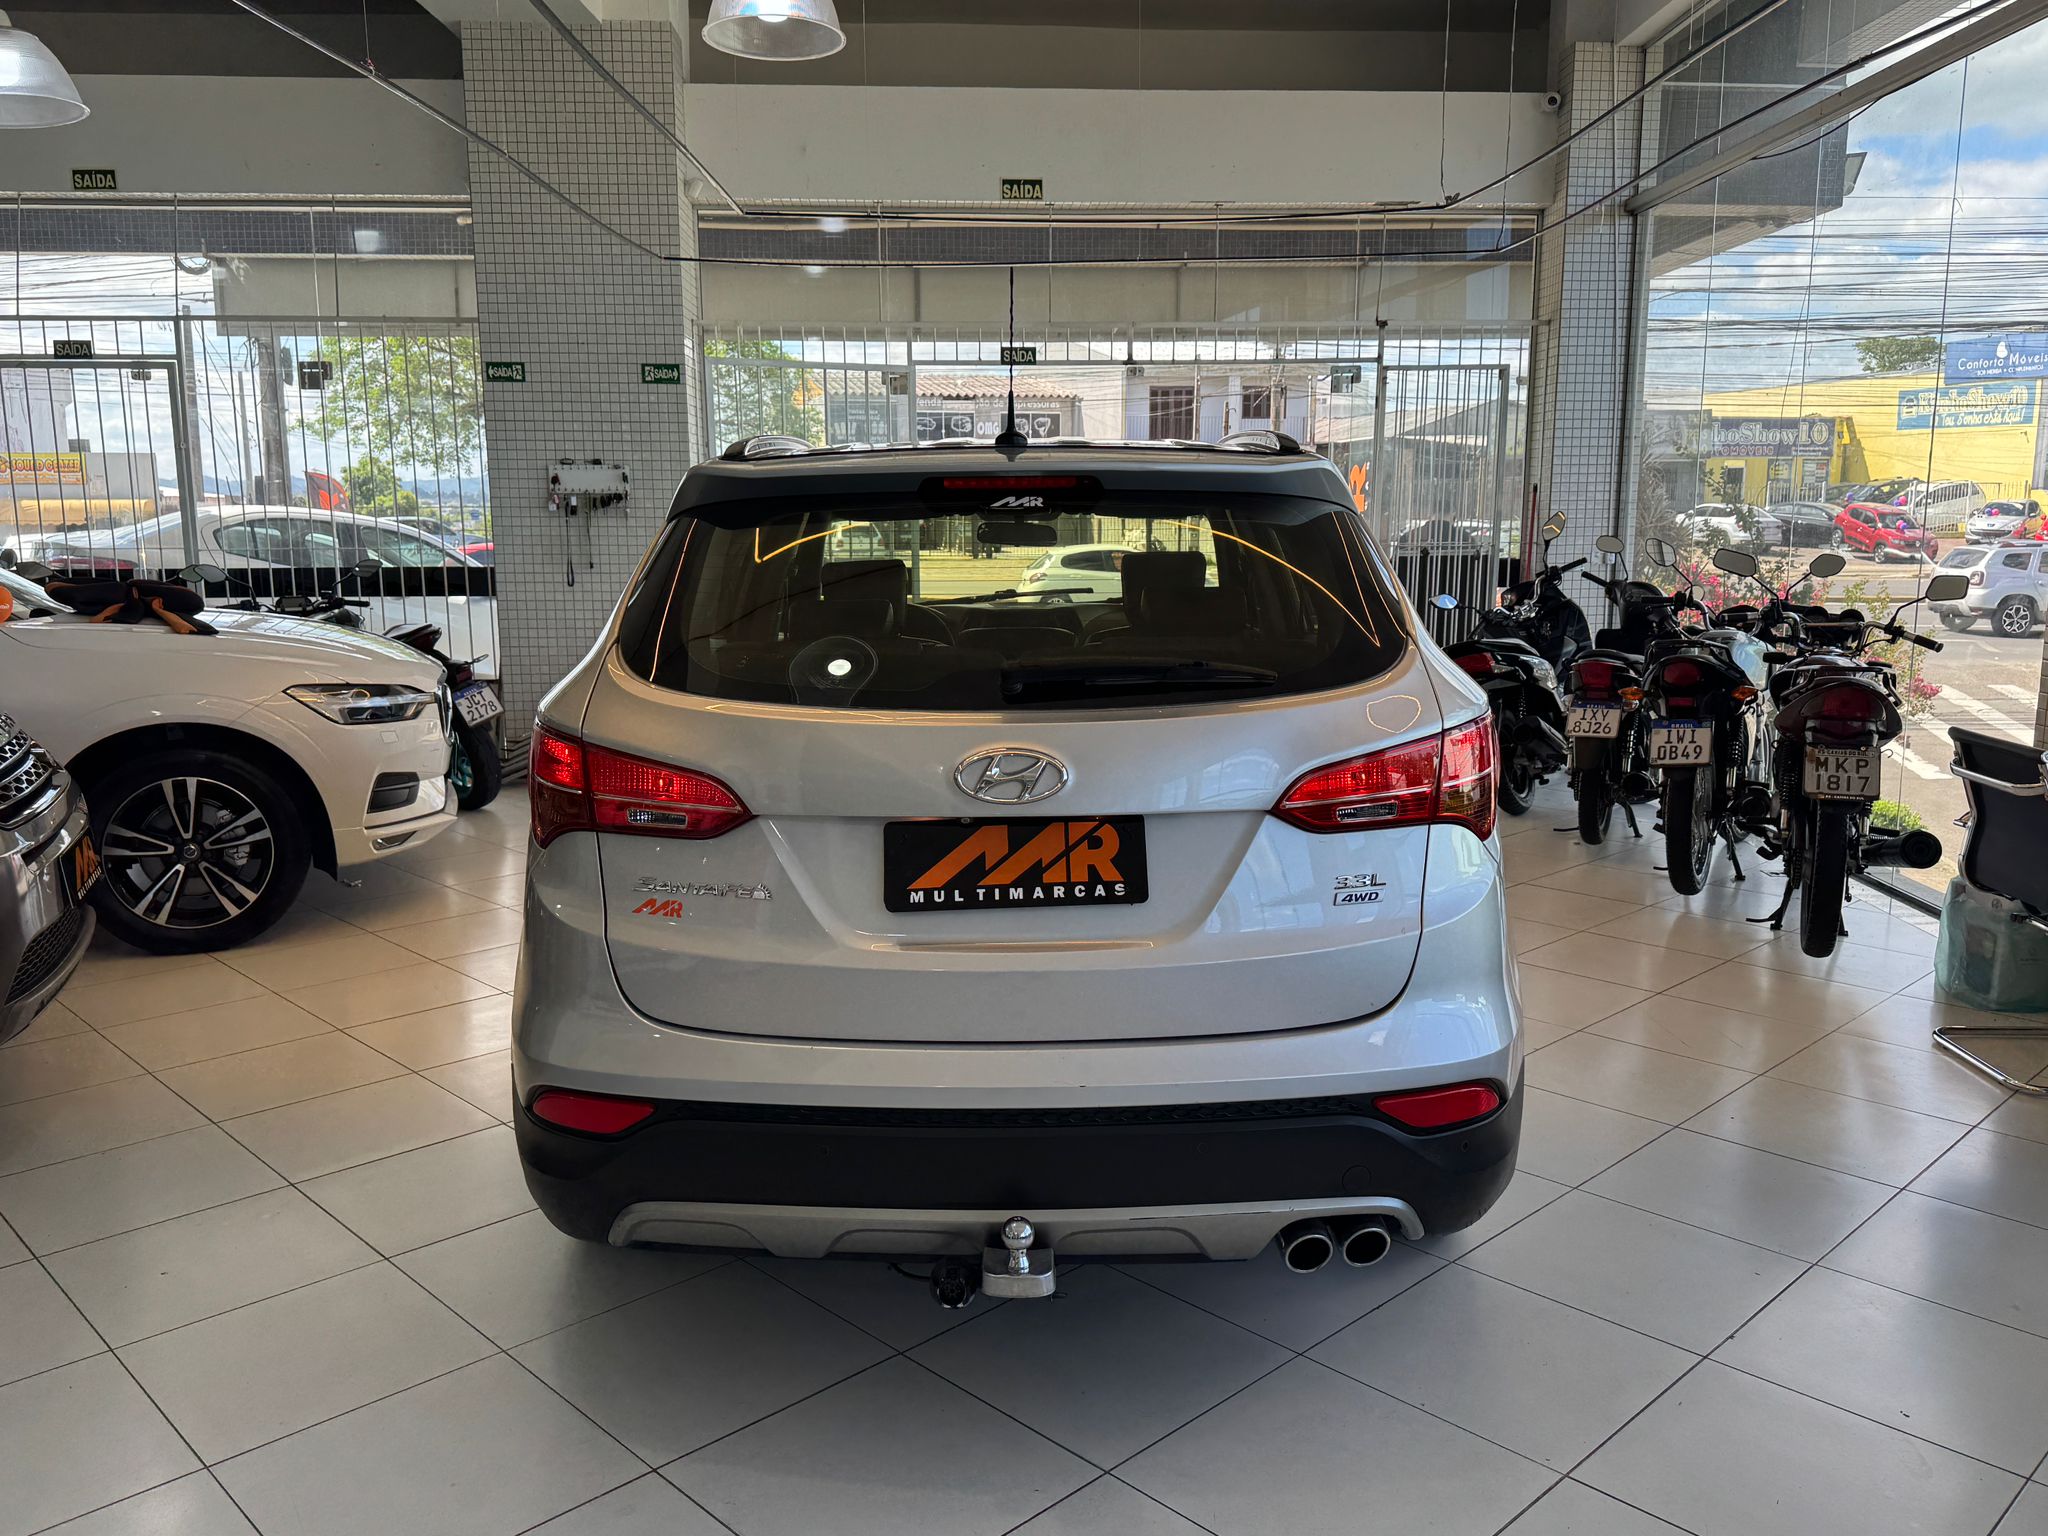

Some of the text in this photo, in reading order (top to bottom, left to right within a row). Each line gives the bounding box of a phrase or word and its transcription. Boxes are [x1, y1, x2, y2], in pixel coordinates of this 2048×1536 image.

[74, 171, 116, 188] SAÍDA
[1003, 180, 1042, 199] SAÍDA
[56, 342, 90, 356] SAÍDA
[1003, 348, 1034, 362] SAÍDA
[1958, 352, 2048, 370] Conforto Móveis
[493, 365, 513, 377] SAÍDA
[654, 367, 673, 379] SAÍDA
[1957, 411, 1983, 426] Sonho
[465, 691, 487, 709] JCT
[467, 701, 497, 721] 2178
[1580, 709, 1609, 721] IXY
[1573, 721, 1612, 734] 8J26
[1664, 729, 1697, 744] IWI
[1815, 756, 1869, 775] MKP
[1816, 773, 1870, 792] 1817
[909, 883, 1126, 904] MULTIMARCAS
[1341, 892, 1379, 902] 4WD
